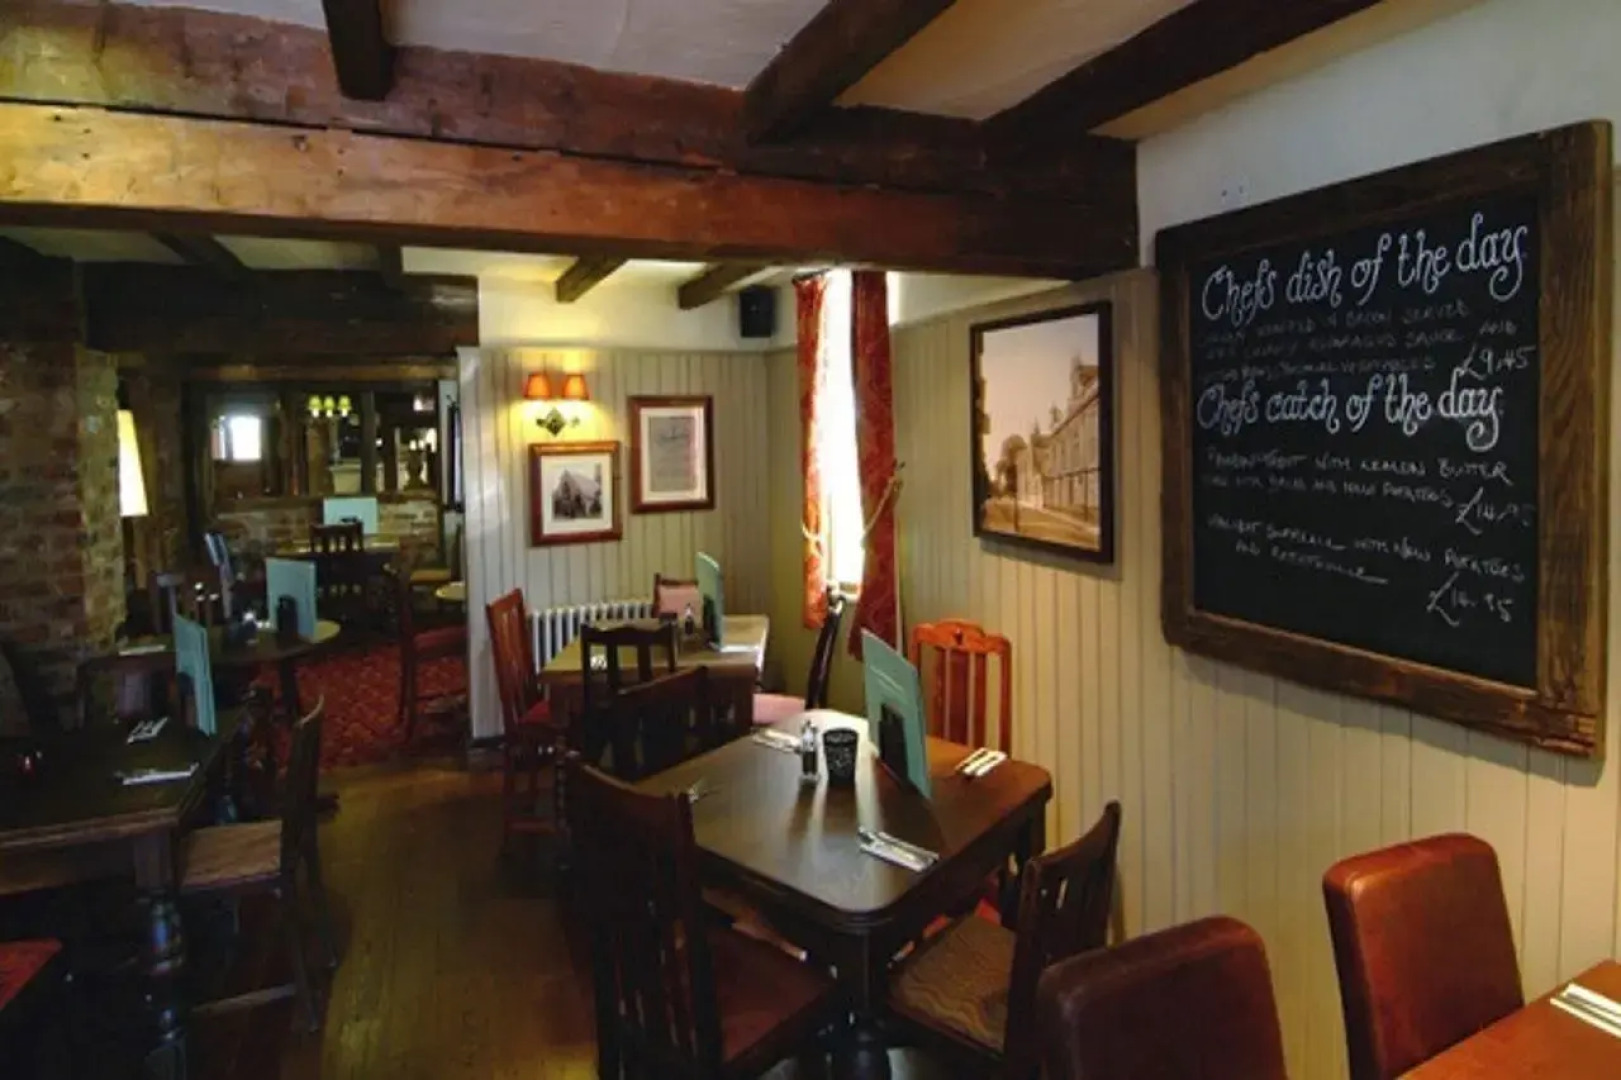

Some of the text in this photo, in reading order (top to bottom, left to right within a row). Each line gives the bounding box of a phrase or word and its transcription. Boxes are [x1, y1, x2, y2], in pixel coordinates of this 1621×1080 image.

[1286, 248, 1343, 309] dish
[1351, 233, 1391, 306] of
[1398, 228, 1451, 294] the
[1456, 211, 1528, 302] day
[1265, 378, 1340, 434] catch
[1346, 373, 1383, 433] of
[1384, 372, 1431, 436] the
[1438, 366, 1504, 452] day
[1437, 456, 1515, 486] BUTTER
